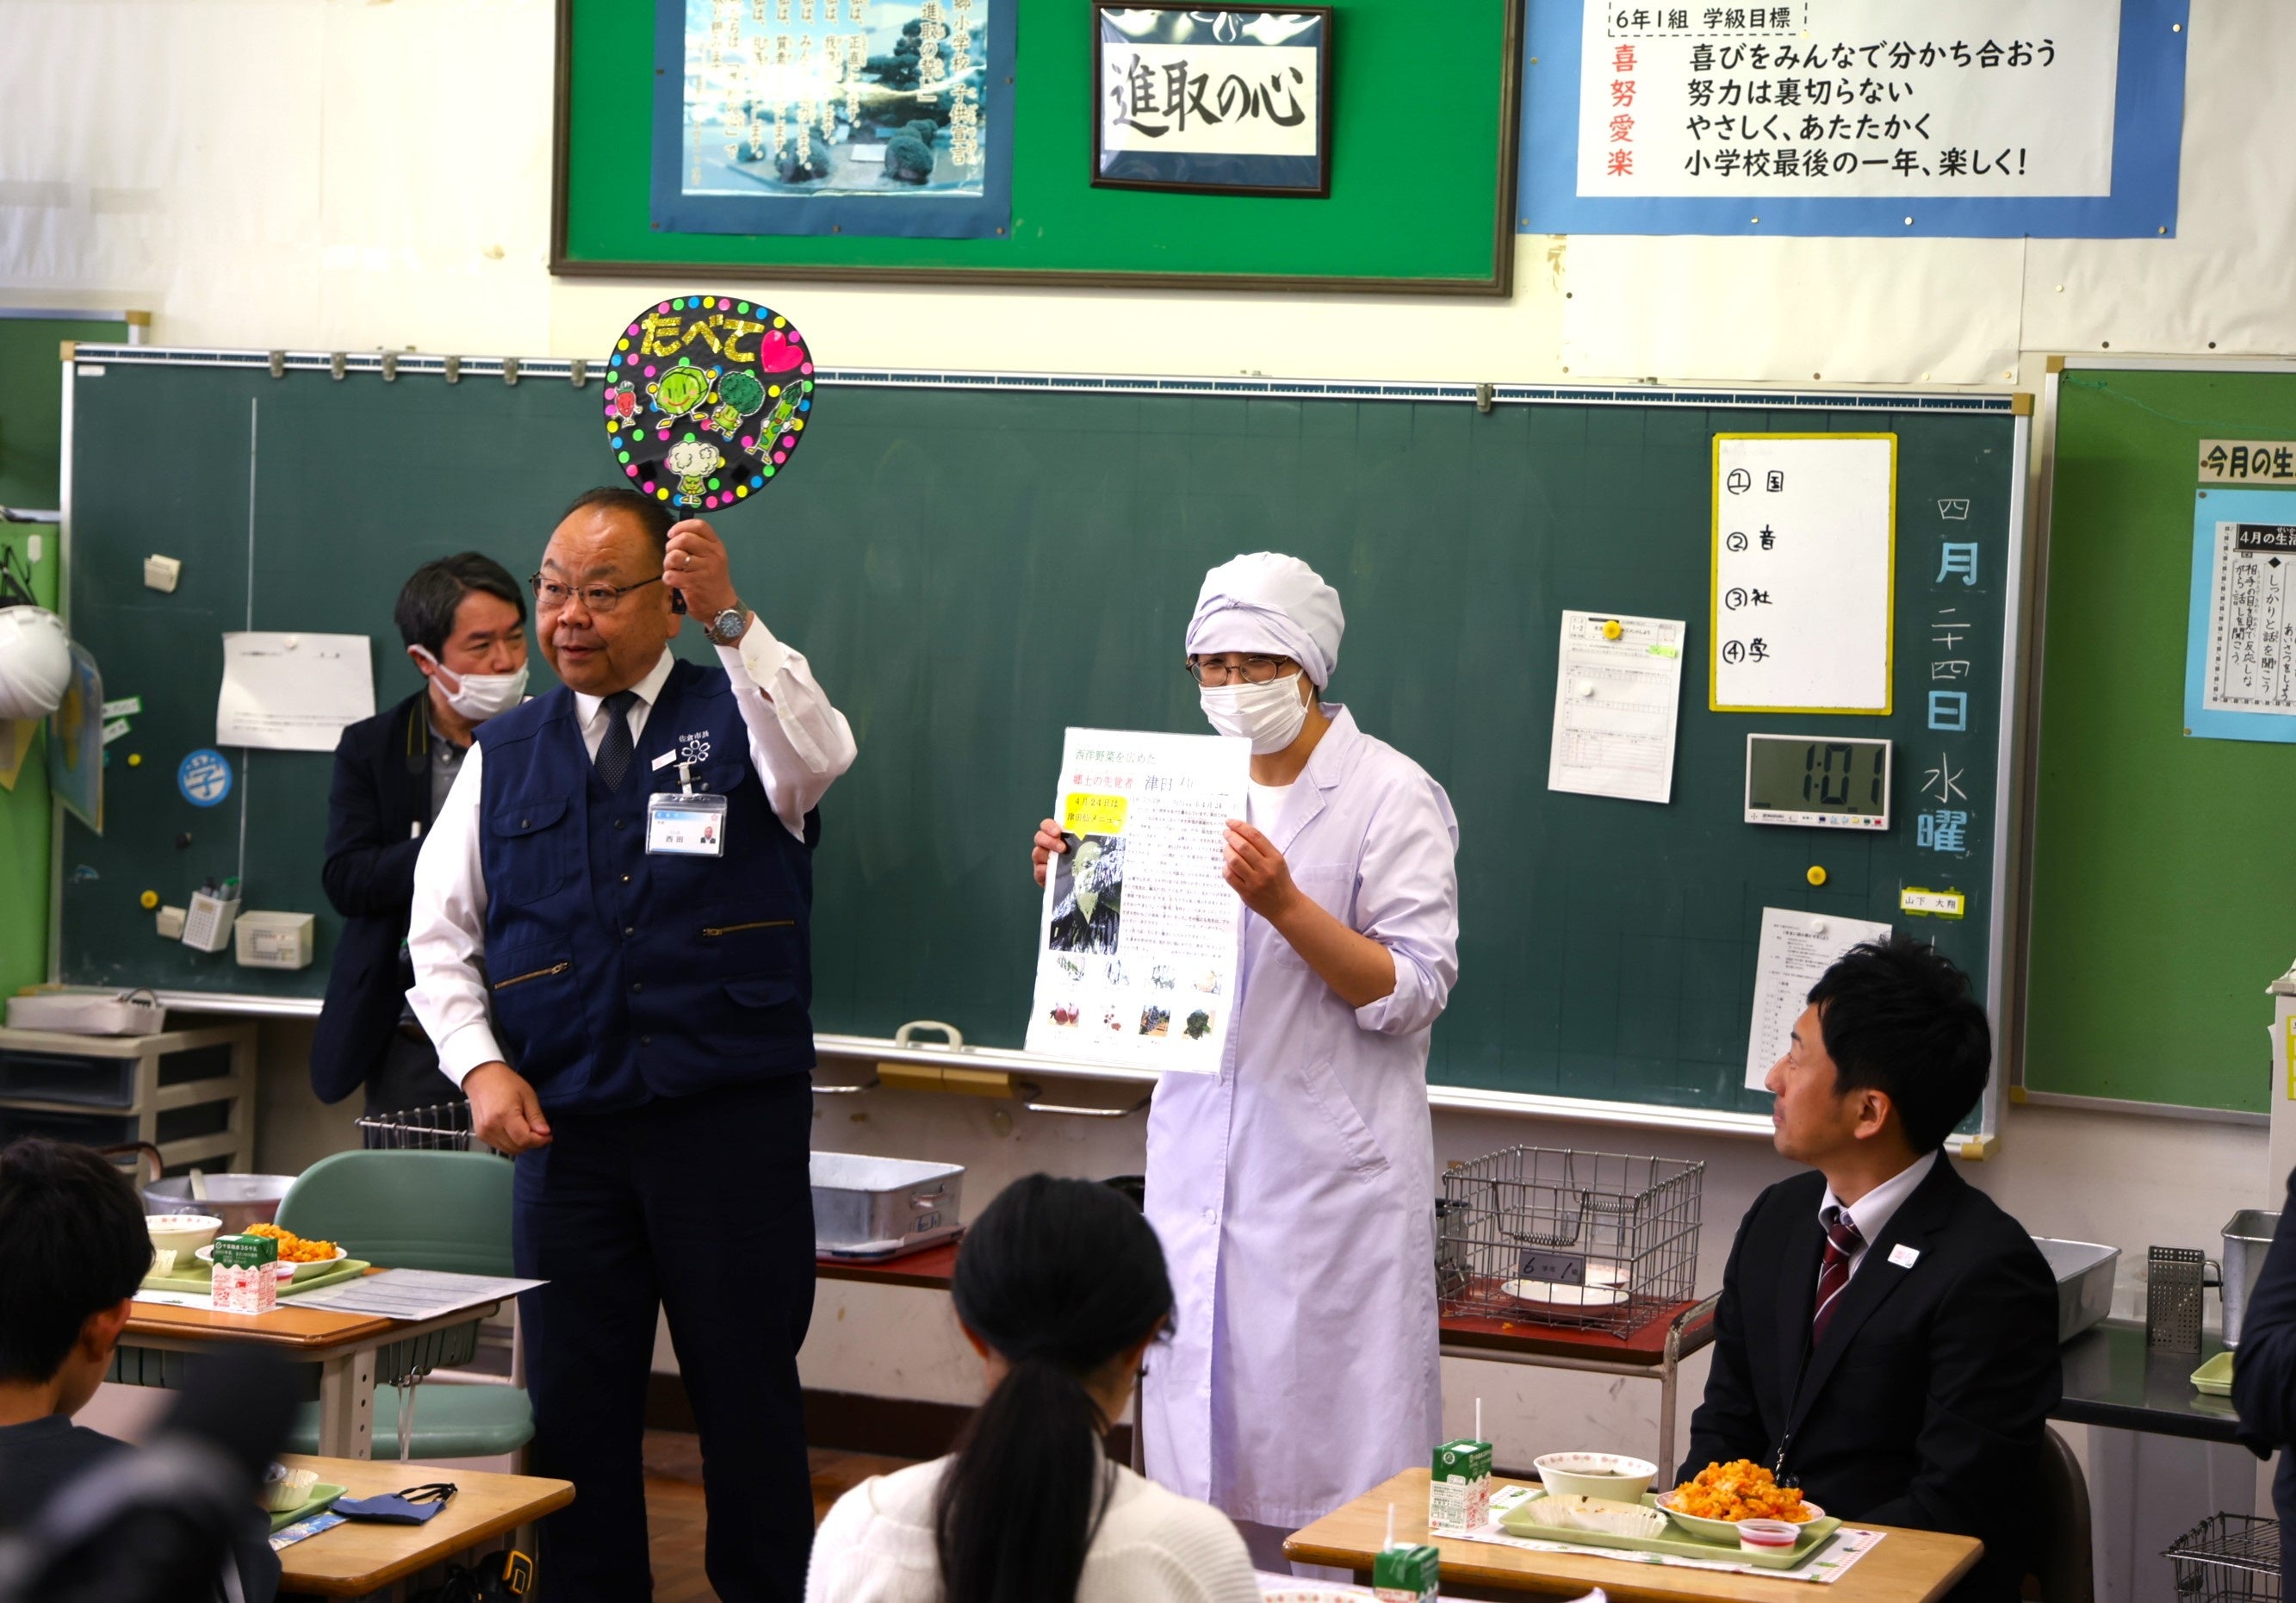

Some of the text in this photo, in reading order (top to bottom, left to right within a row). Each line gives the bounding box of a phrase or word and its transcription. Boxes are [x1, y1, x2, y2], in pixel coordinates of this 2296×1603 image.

[1703, 7, 1790, 29] 学級目標
[1612, 39, 2057, 72] 喜 喜びをみんなで分かち合おう
[1109, 53, 1306, 138] 進取の心
[1610, 78, 1914, 108] 努 努力は裏切らない
[1609, 113, 1931, 143] 愛 やさしく、あたたかく
[1607, 148, 2026, 179] 楽 小学校最後の一年、楽しく!
[641, 312, 765, 363] たべて
[2207, 444, 2296, 478] 今月の生
[1766, 470, 1784, 493] 国
[1759, 524, 1776, 550] 音
[2261, 575, 2280, 693] しっかりと話を聞こう
[184, 755, 227, 798] 学
[1072, 773, 1134, 790] 郷土の先覚者
[1803, 743, 1883, 805] 1:01
[1075, 796, 1120, 808] 4月24日は
[1905, 896, 1926, 906] 山下
[1523, 1257, 1536, 1274] 6
